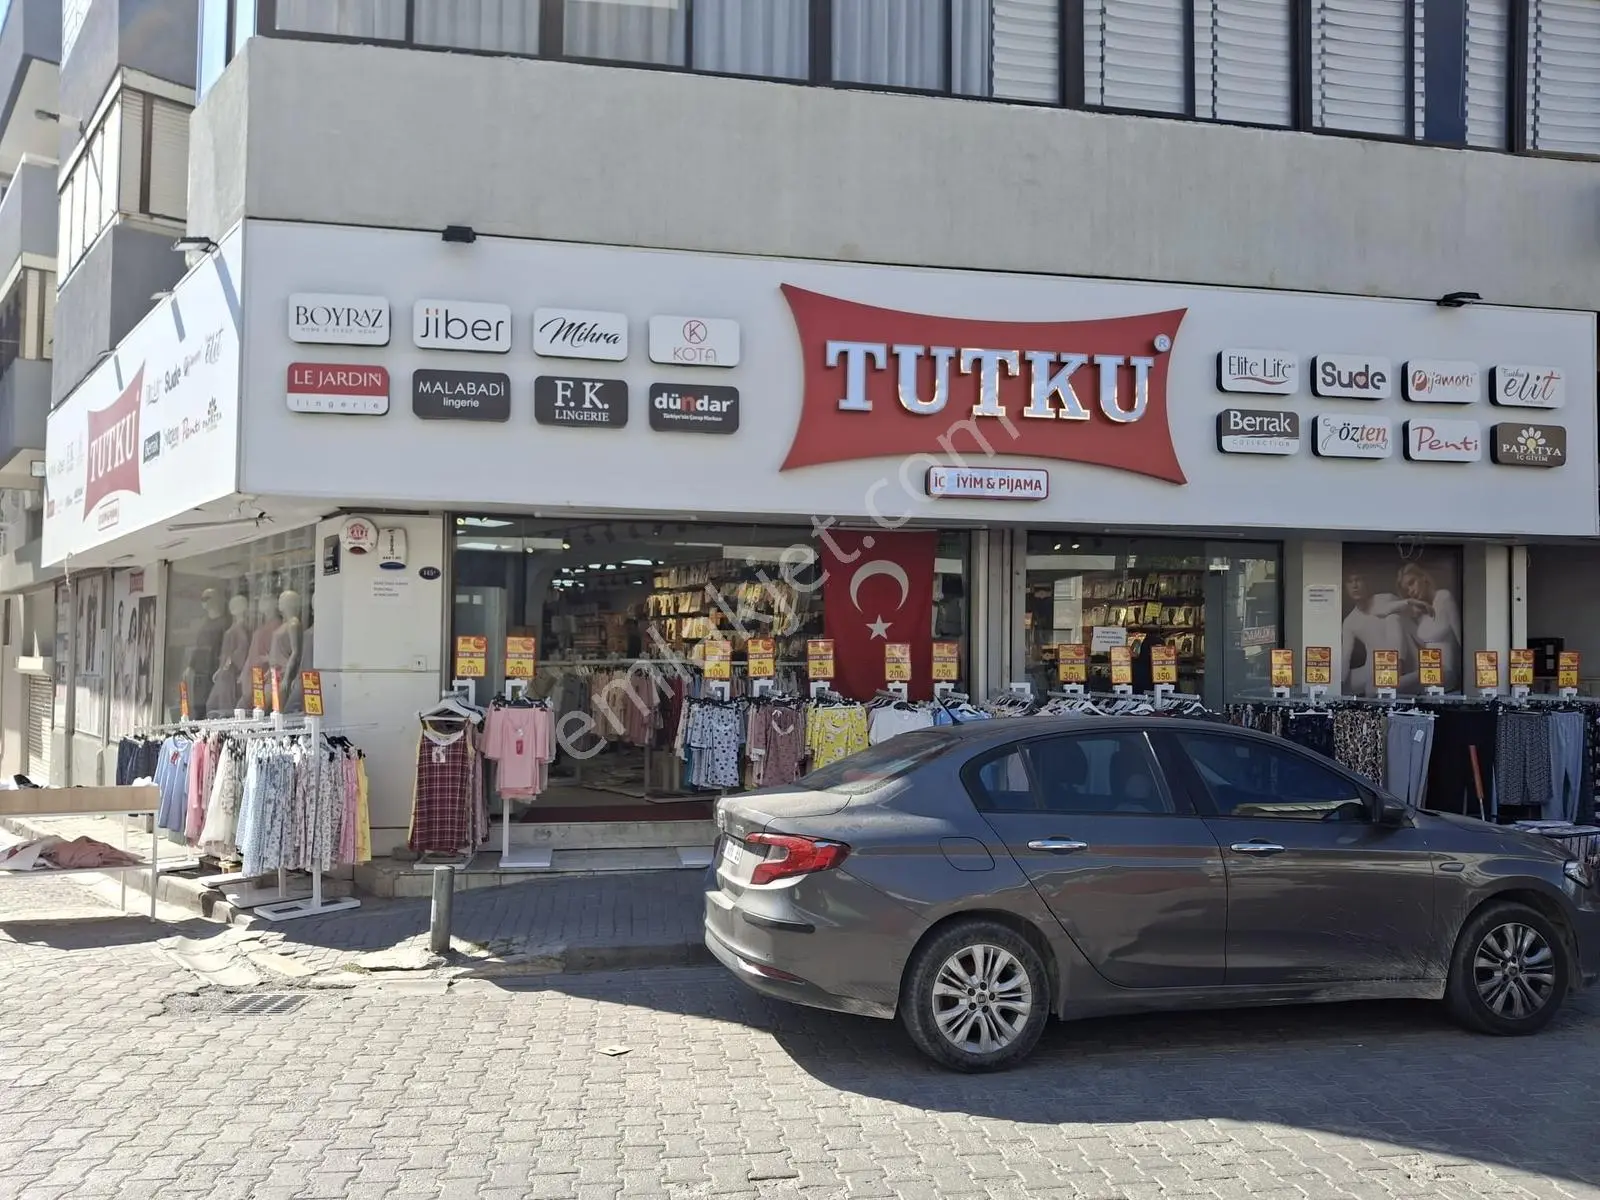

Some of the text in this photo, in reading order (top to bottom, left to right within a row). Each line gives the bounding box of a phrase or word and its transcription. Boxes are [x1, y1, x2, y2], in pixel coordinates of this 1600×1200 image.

[296, 305, 383, 328] BOYRAZ
[420, 308, 504, 341] jiber
[539, 316, 621, 348] Mihra
[673, 346, 717, 362] KOTA
[1228, 355, 1258, 376] Elite
[1321, 361, 1387, 390] Sude
[294, 369, 382, 389] LE JARDIN
[825, 340, 1154, 423] TUTKU
[1504, 371, 1561, 401] elit
[296, 399, 379, 410] lingerie
[443, 397, 480, 409] lingerie
[554, 380, 610, 409] F. K.
[654, 392, 730, 412] dündar
[555, 409, 610, 422] LINGERIE
[1229, 410, 1292, 433] Berrak
[1338, 422, 1388, 443] özten
[1412, 426, 1478, 452] Penti
[90, 410, 137, 482] TUTKU
[1502, 443, 1562, 457] PAPATYA
[986, 477, 996, 490] &
[998, 474, 1043, 493] PİJAMA
[752, 666, 768, 675] 200
[1156, 672, 1170, 681] 350
